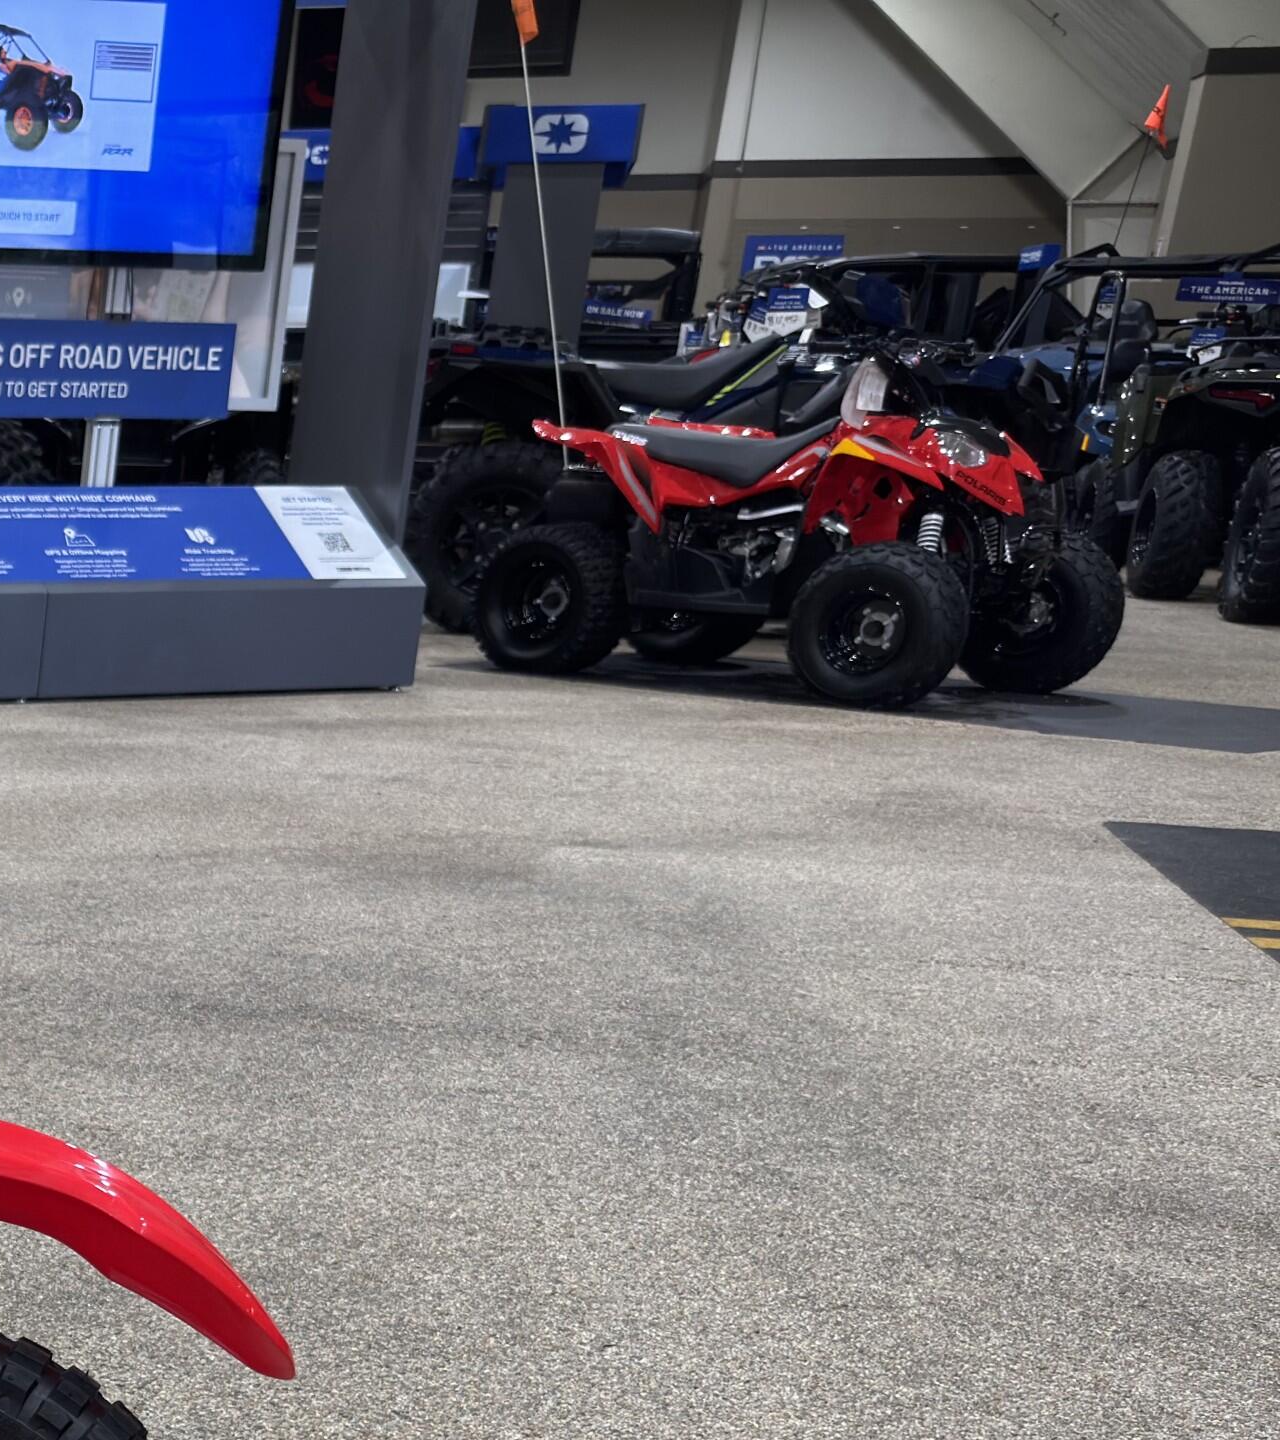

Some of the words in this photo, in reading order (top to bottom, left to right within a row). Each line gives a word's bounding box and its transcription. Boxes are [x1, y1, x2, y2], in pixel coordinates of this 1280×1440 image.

[22, 212, 33, 221] TO
[34, 212, 61, 222] START
[1190, 286, 1211, 294] THE
[1214, 286, 1269, 296] AMERICAN
[586, 305, 599, 314] ON
[600, 306, 622, 317] SALE
[623, 309, 645, 319] NOW
[9, 344, 55, 369] OFF
[59, 345, 122, 370] ROAD
[127, 346, 223, 371] VEHICLE
[5, 381, 26, 398] TO
[28, 382, 58, 398] GET
[60, 382, 129, 399] STARTED
[955, 470, 1006, 506] POLARIS
[27, 494, 53, 503] RIDE
[52, 494, 81, 503] WITH
[80, 495, 106, 503] RIDE
